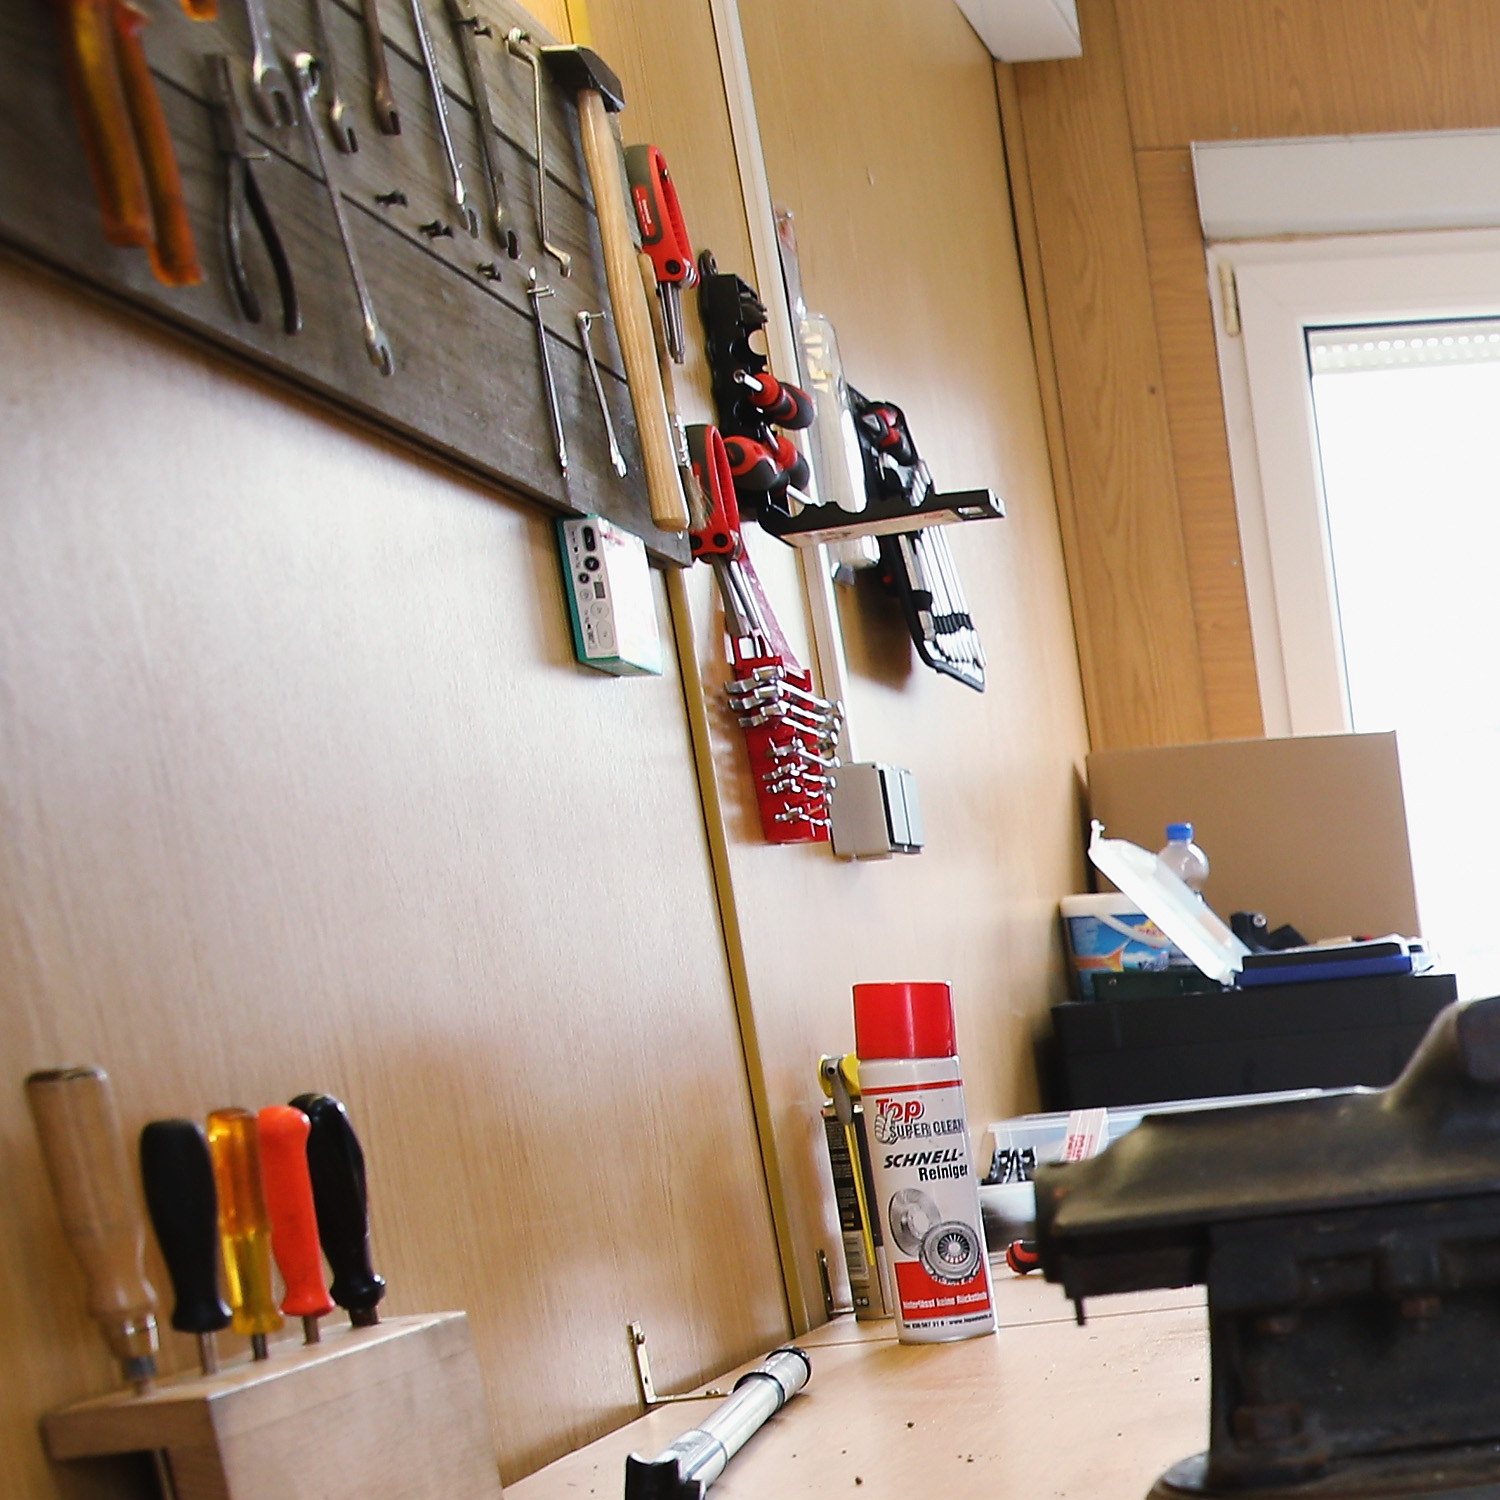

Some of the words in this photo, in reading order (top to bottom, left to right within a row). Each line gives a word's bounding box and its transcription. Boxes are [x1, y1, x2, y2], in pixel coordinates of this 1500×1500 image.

[875, 1098, 925, 1124] Top
[889, 1121, 932, 1140] SUPER
[883, 1148, 964, 1169] SCHNELL-
